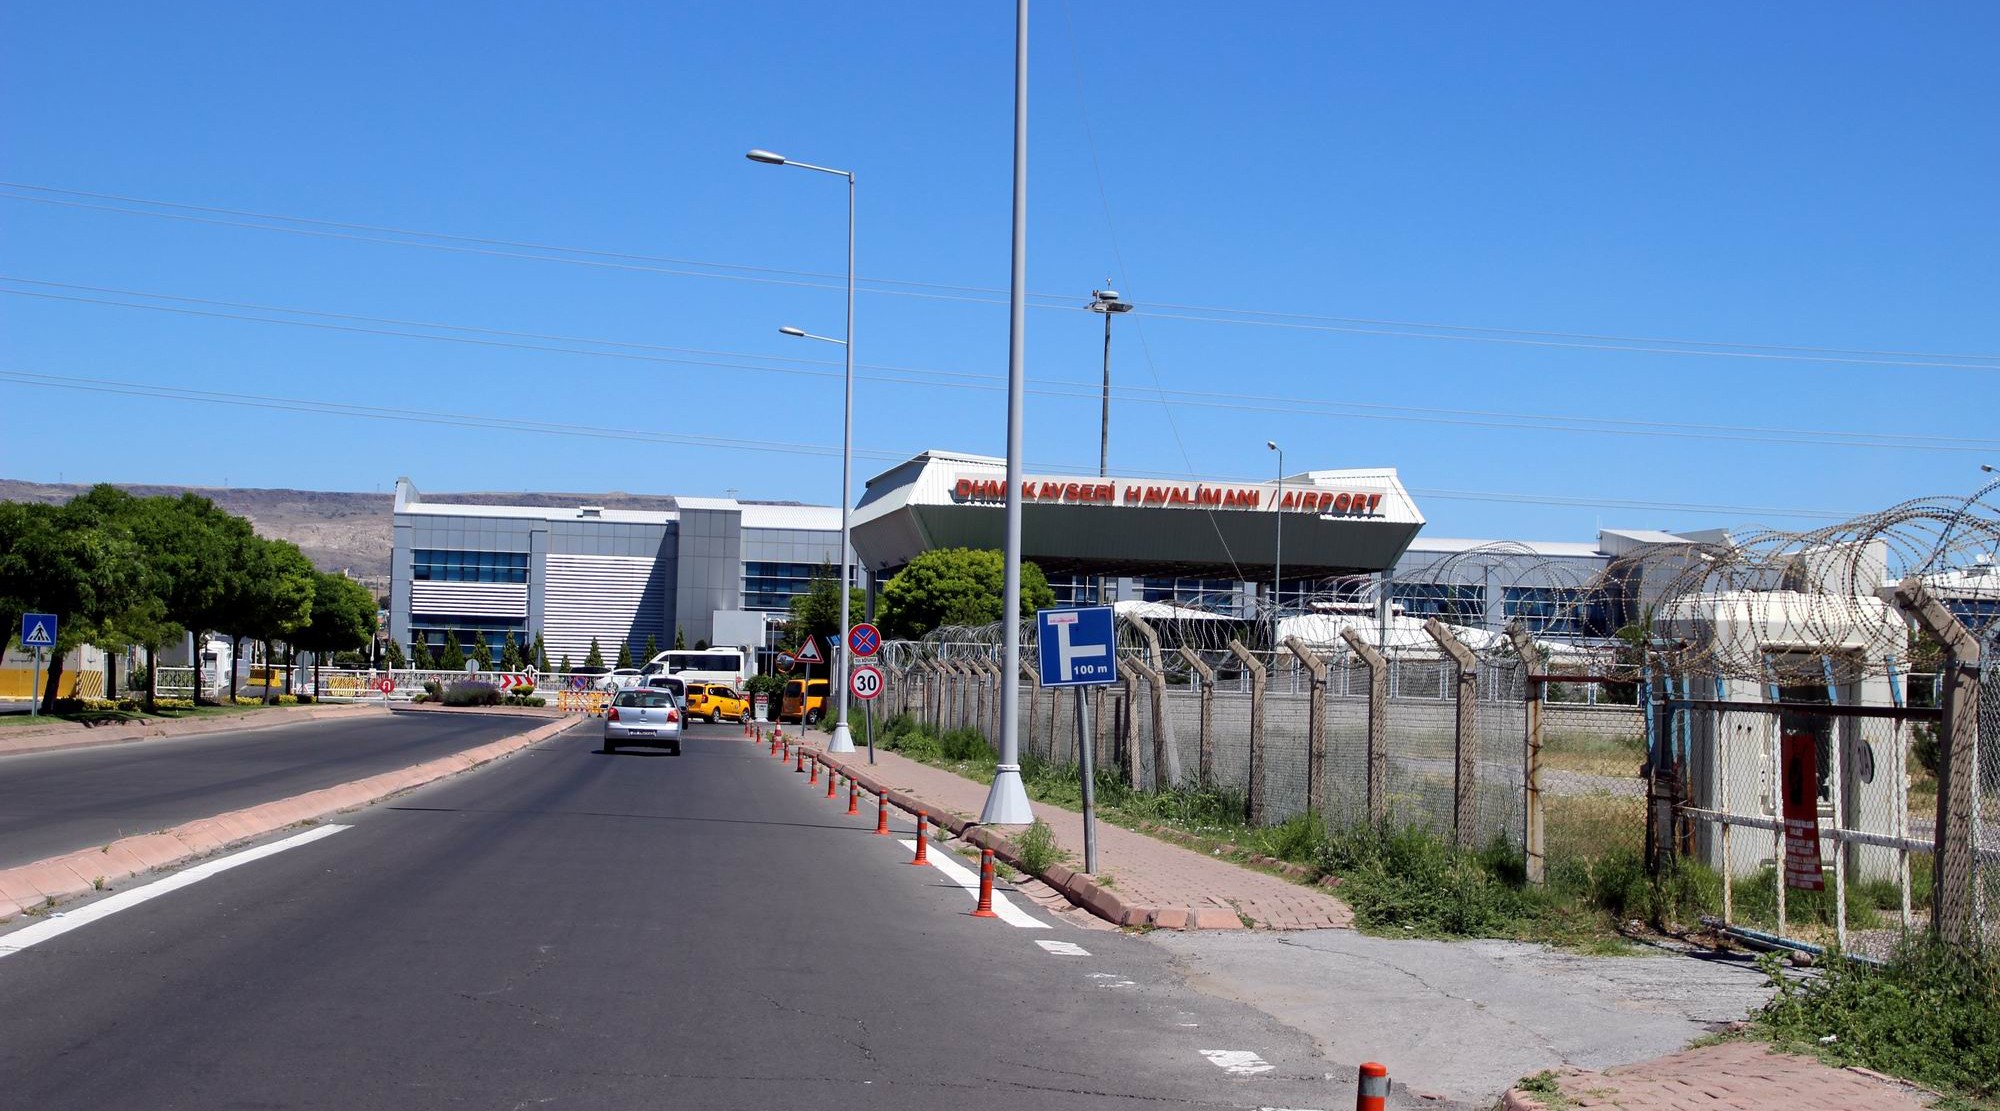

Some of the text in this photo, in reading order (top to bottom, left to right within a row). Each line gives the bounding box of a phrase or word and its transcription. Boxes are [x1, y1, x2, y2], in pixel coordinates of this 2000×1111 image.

[956, 479, 1006, 499] DHM
[1022, 481, 1115, 501] KAYSERİ
[1125, 484, 1260, 506] HAVALİMANI
[1280, 491, 1383, 513] AIRPORT
[1073, 664, 1107, 675] 100 m
[857, 675, 877, 691] 30
